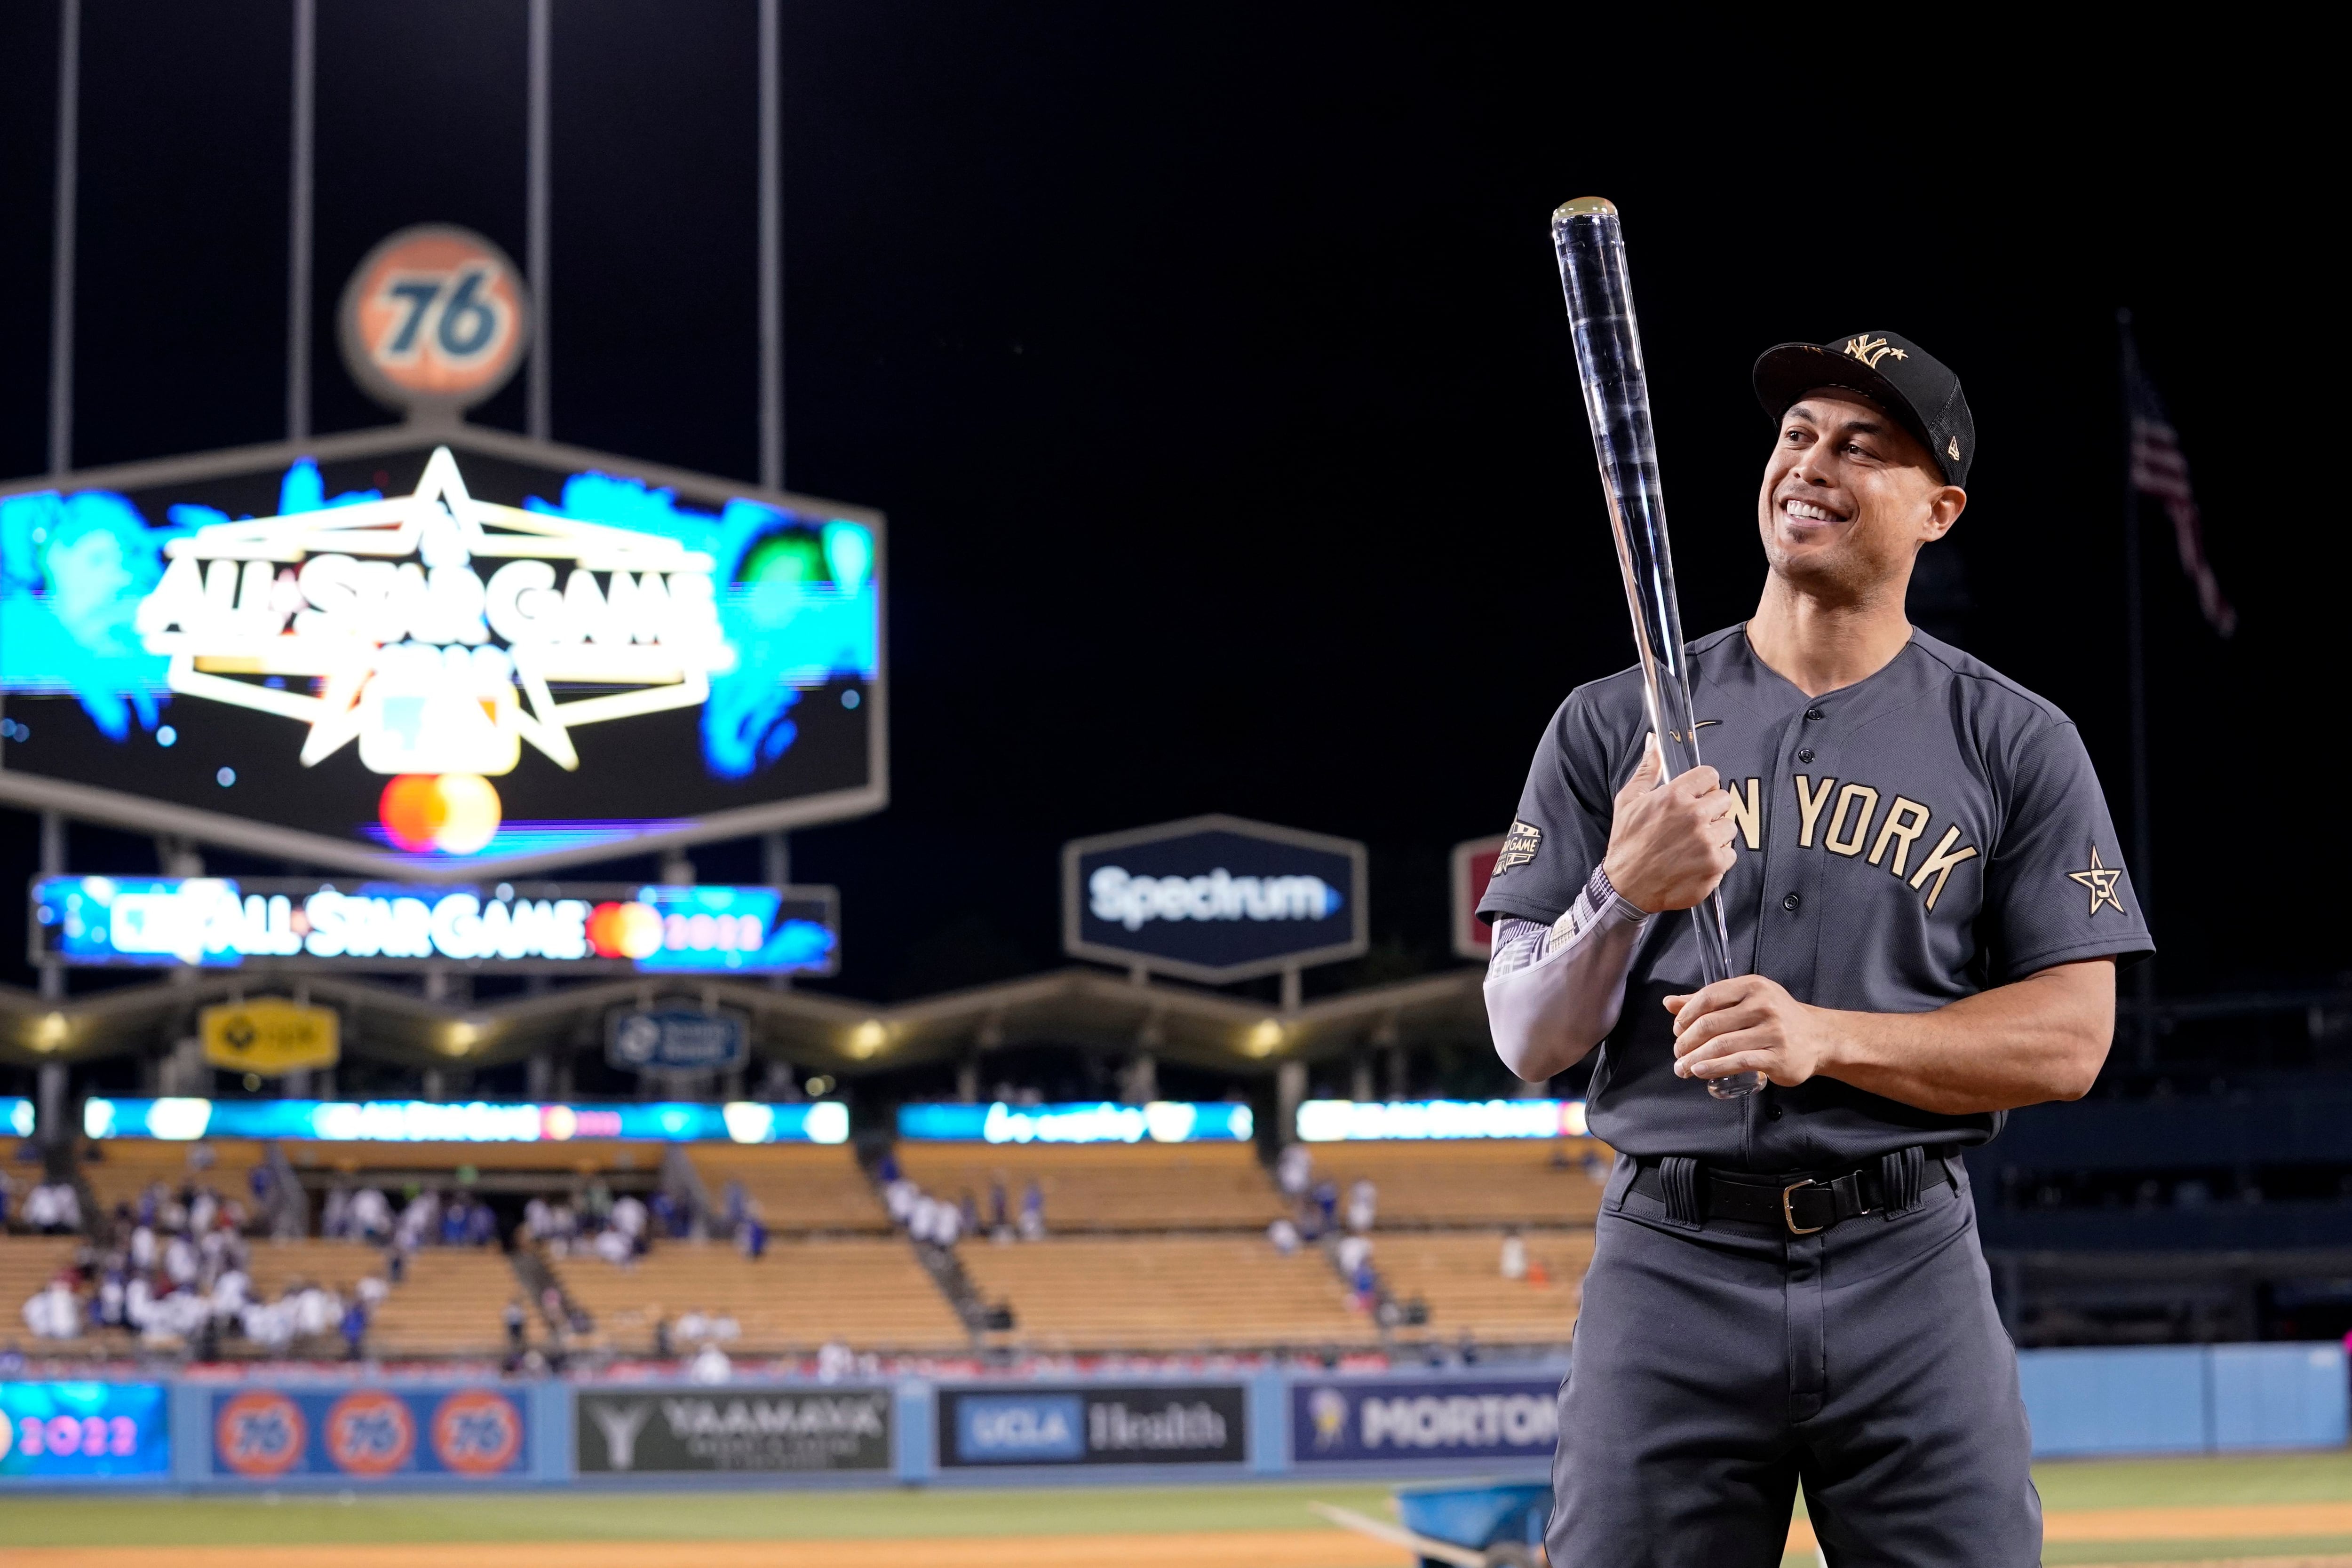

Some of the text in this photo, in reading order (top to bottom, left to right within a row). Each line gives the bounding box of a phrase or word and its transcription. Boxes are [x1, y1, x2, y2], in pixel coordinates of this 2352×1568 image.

[389, 271, 496, 356] 76
[485, 560, 716, 645] GAME
[1509, 837, 1538, 852] GAME
[1793, 774, 1980, 913] YORK
[1089, 866, 1327, 931] Spectrum
[2091, 870, 2110, 898] 5
[430, 894, 586, 959] GAME
